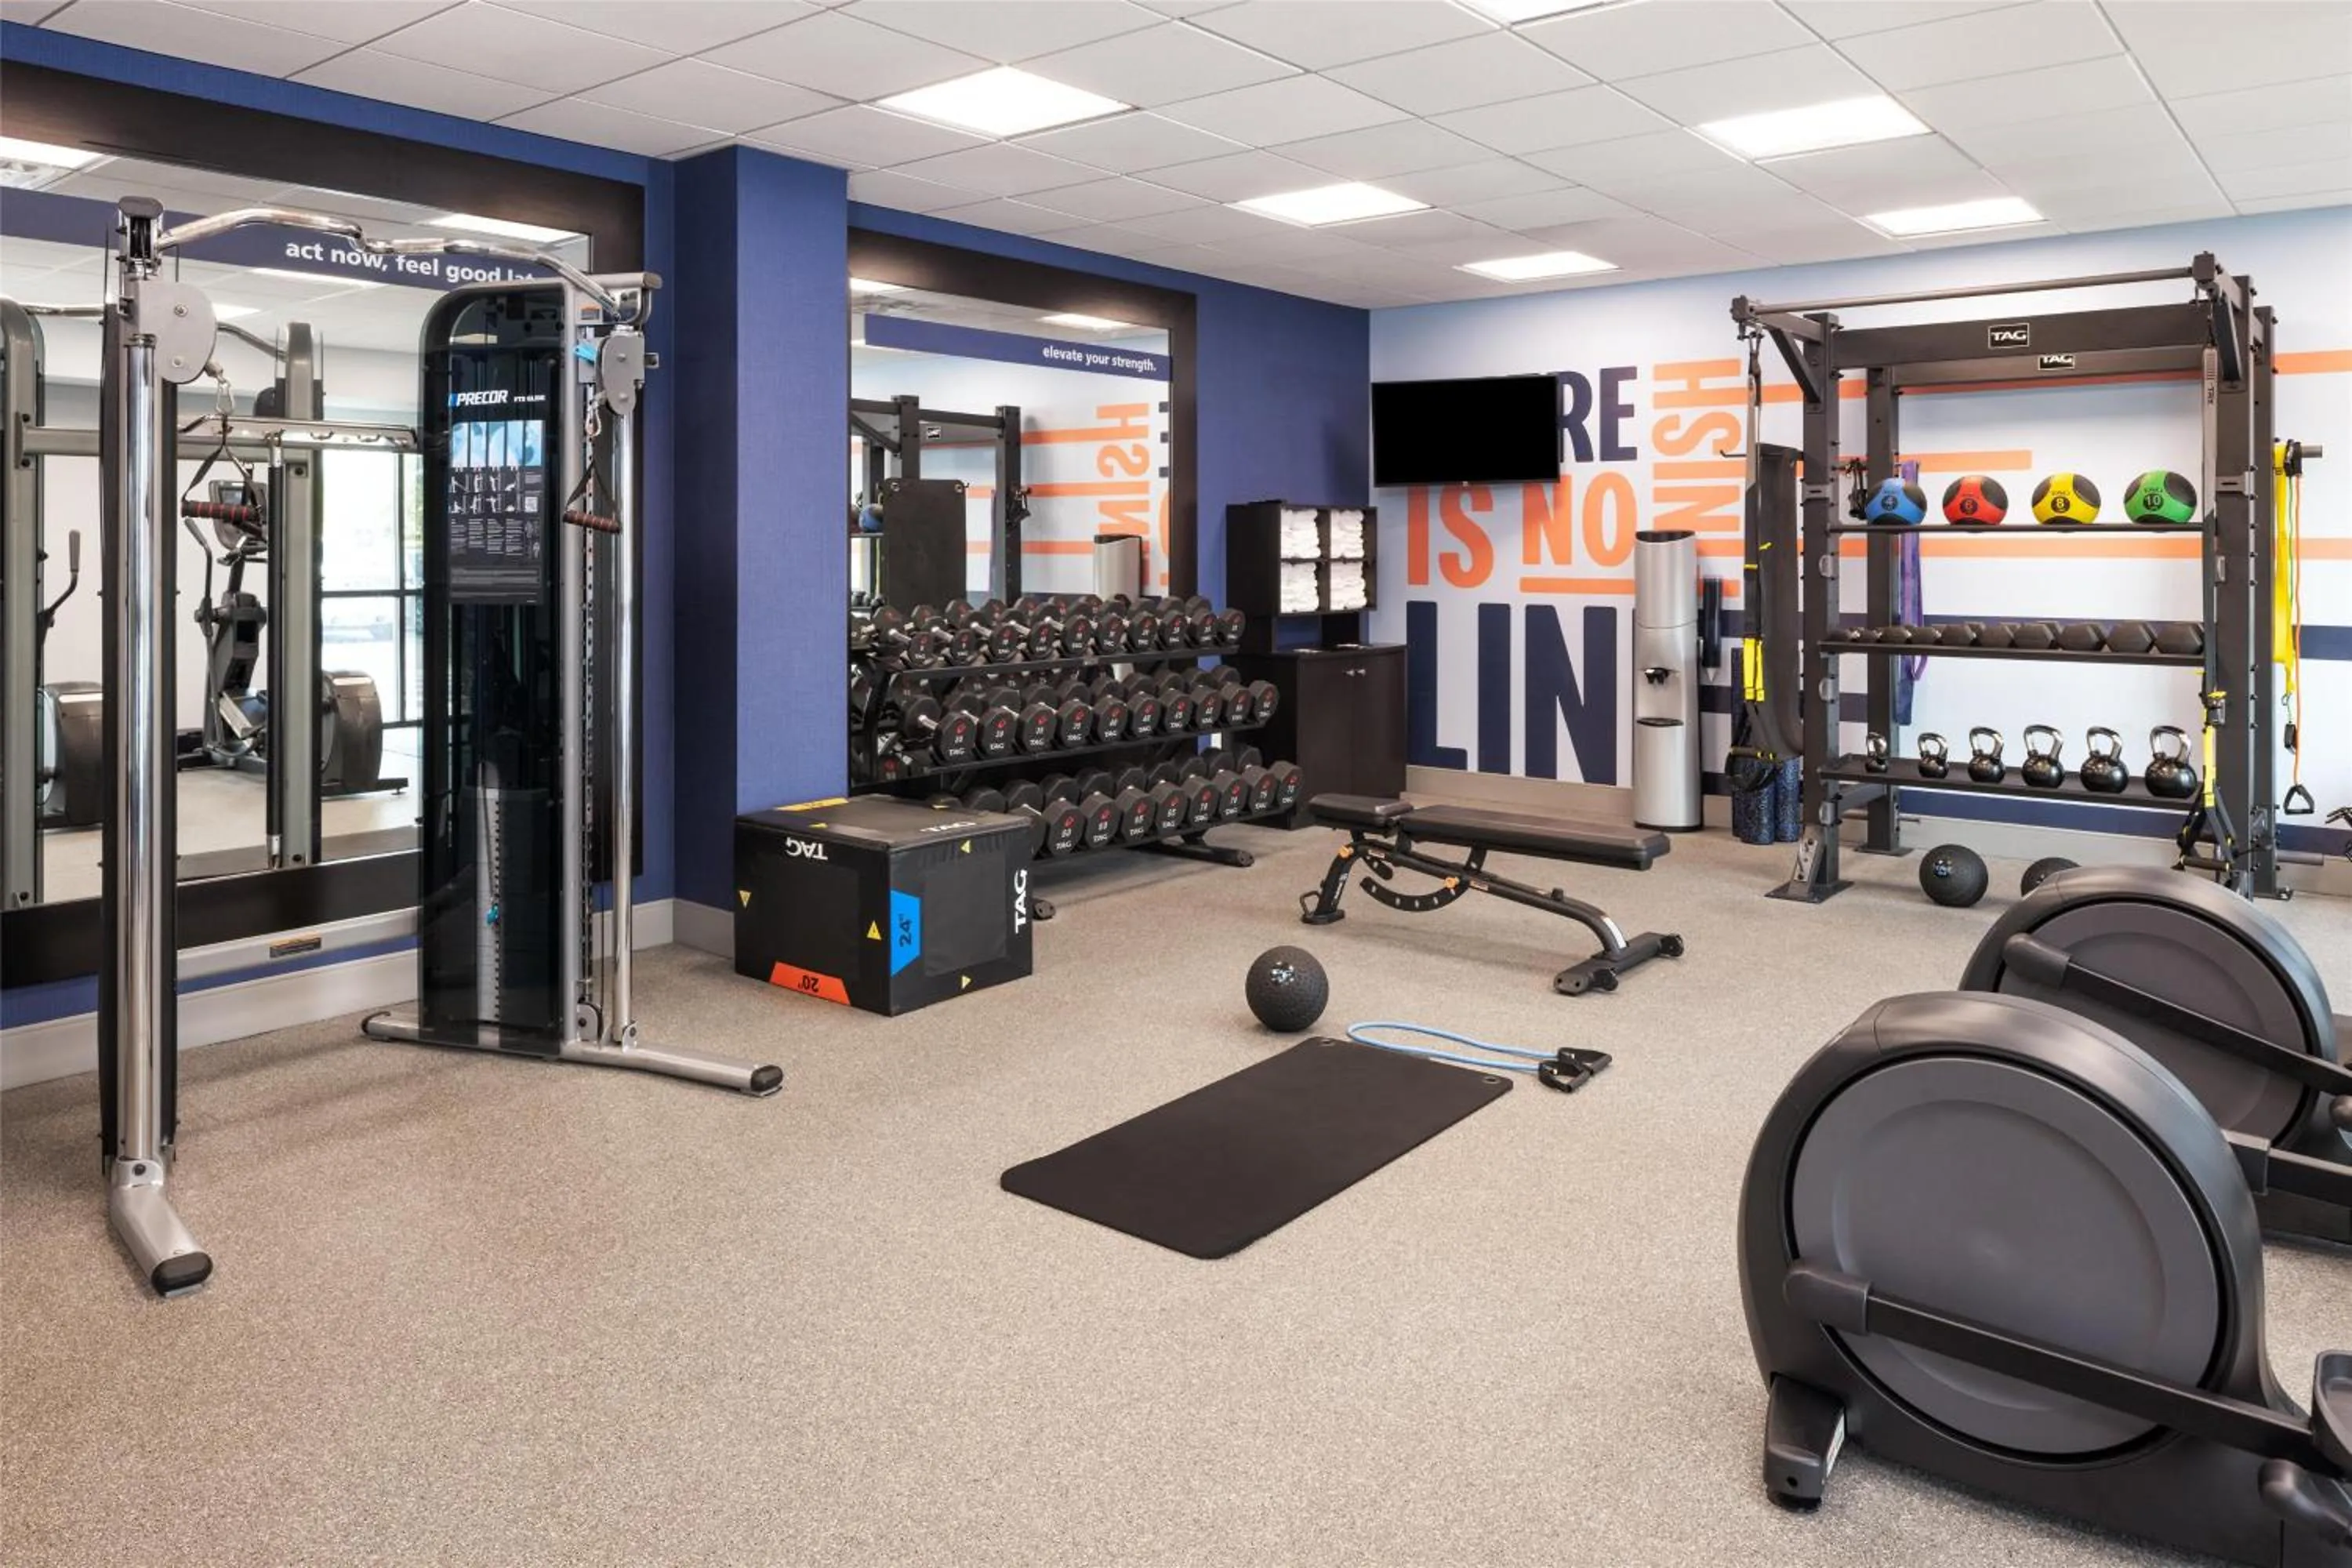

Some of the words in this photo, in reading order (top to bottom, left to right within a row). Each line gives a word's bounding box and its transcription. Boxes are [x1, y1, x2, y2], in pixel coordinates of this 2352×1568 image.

[285, 241, 323, 260] act
[330, 249, 388, 271] now,
[396, 255, 439, 276] feel
[445, 267, 501, 283] good
[1991, 330, 2027, 341] TAG
[1043, 345, 1083, 361] elevate
[1085, 353, 1110, 366] your
[1111, 356, 1156, 372] strength.
[456, 390, 509, 407] PRECOR
[2056, 498, 2065, 510] 8
[2145, 495, 2161, 506] 10
[1407, 481, 1494, 588] IS
[1522, 472, 1638, 567] NO
[1406, 601, 1617, 786] LIN
[786, 837, 828, 861] TAG
[1014, 869, 1028, 934] TAG
